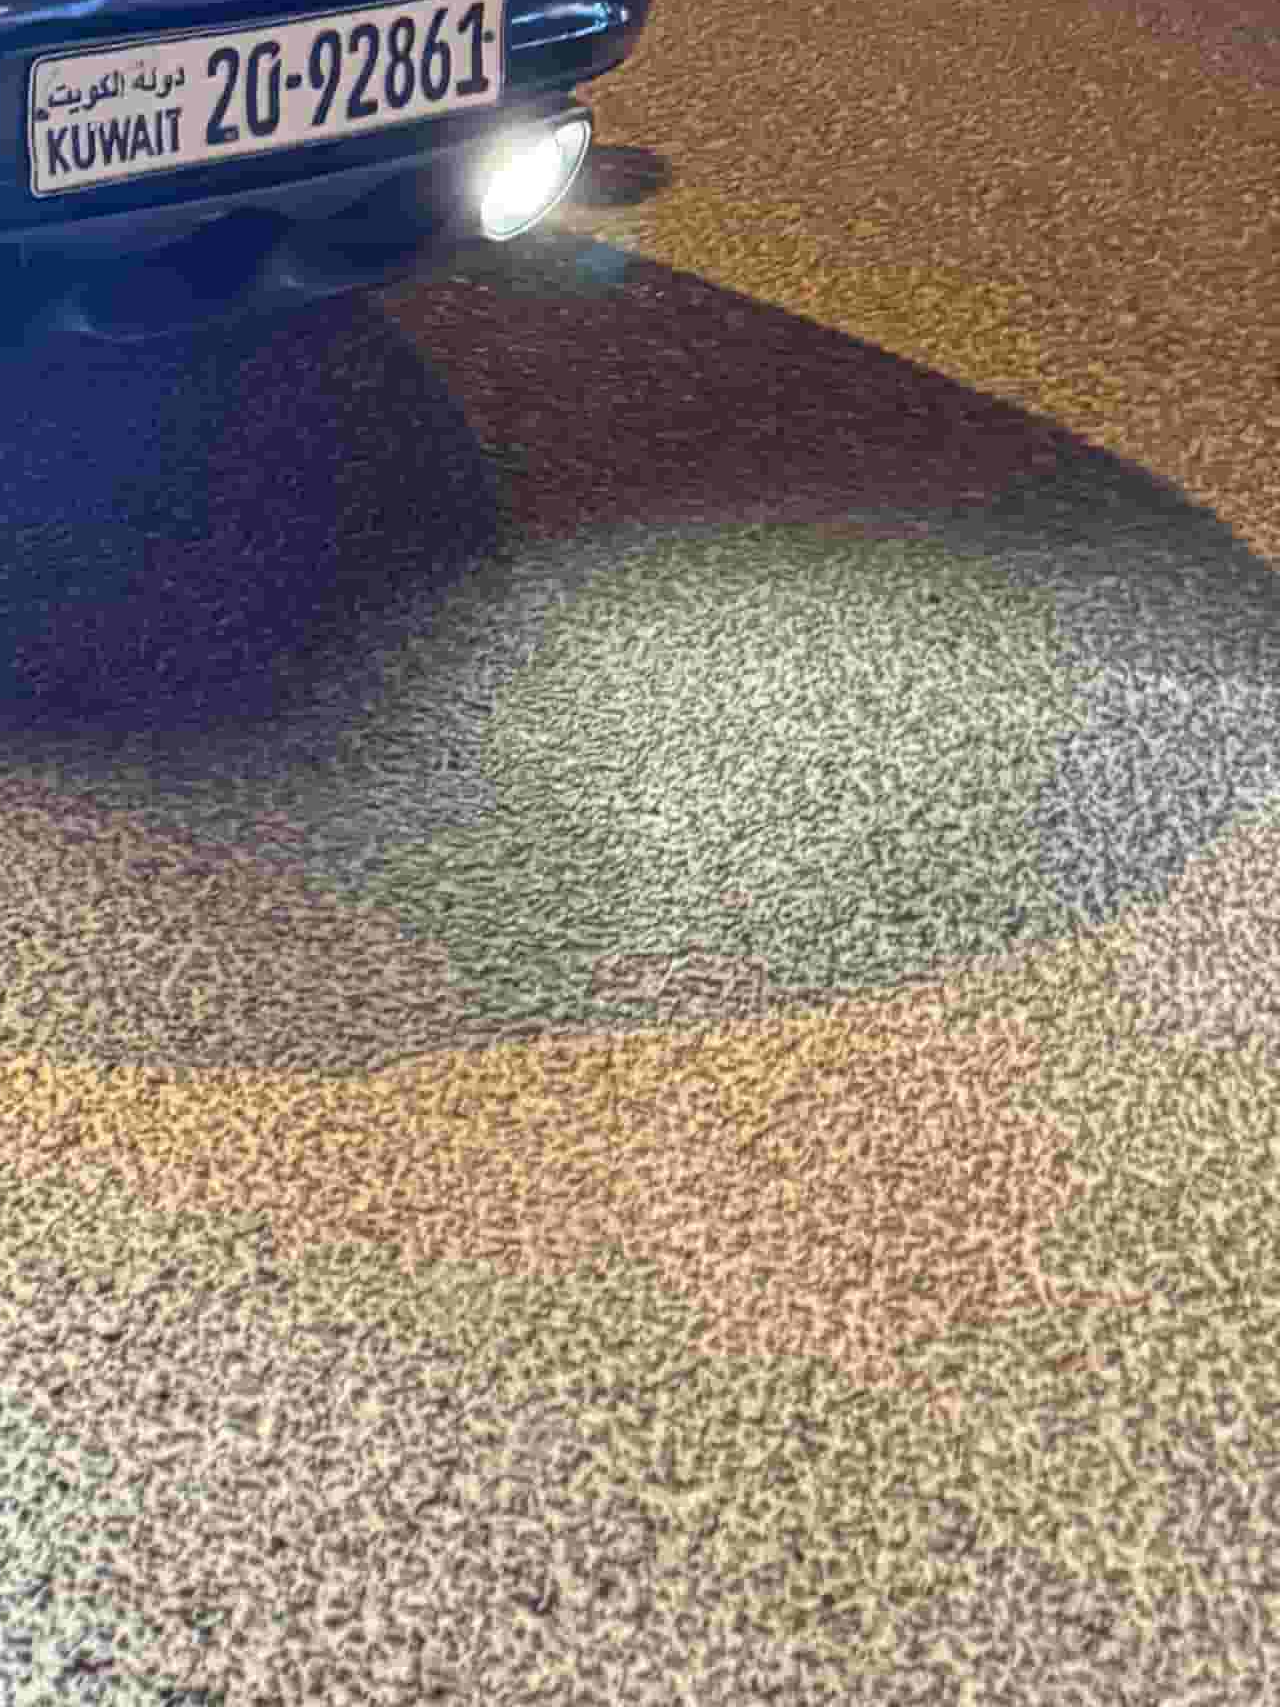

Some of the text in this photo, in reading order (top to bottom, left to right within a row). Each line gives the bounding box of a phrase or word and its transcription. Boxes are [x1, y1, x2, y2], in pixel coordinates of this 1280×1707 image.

[48, 60, 186, 115] دولة الكويت
[205, 1, 489, 147] 20-92861
[47, 106, 183, 177] KUWAIT
